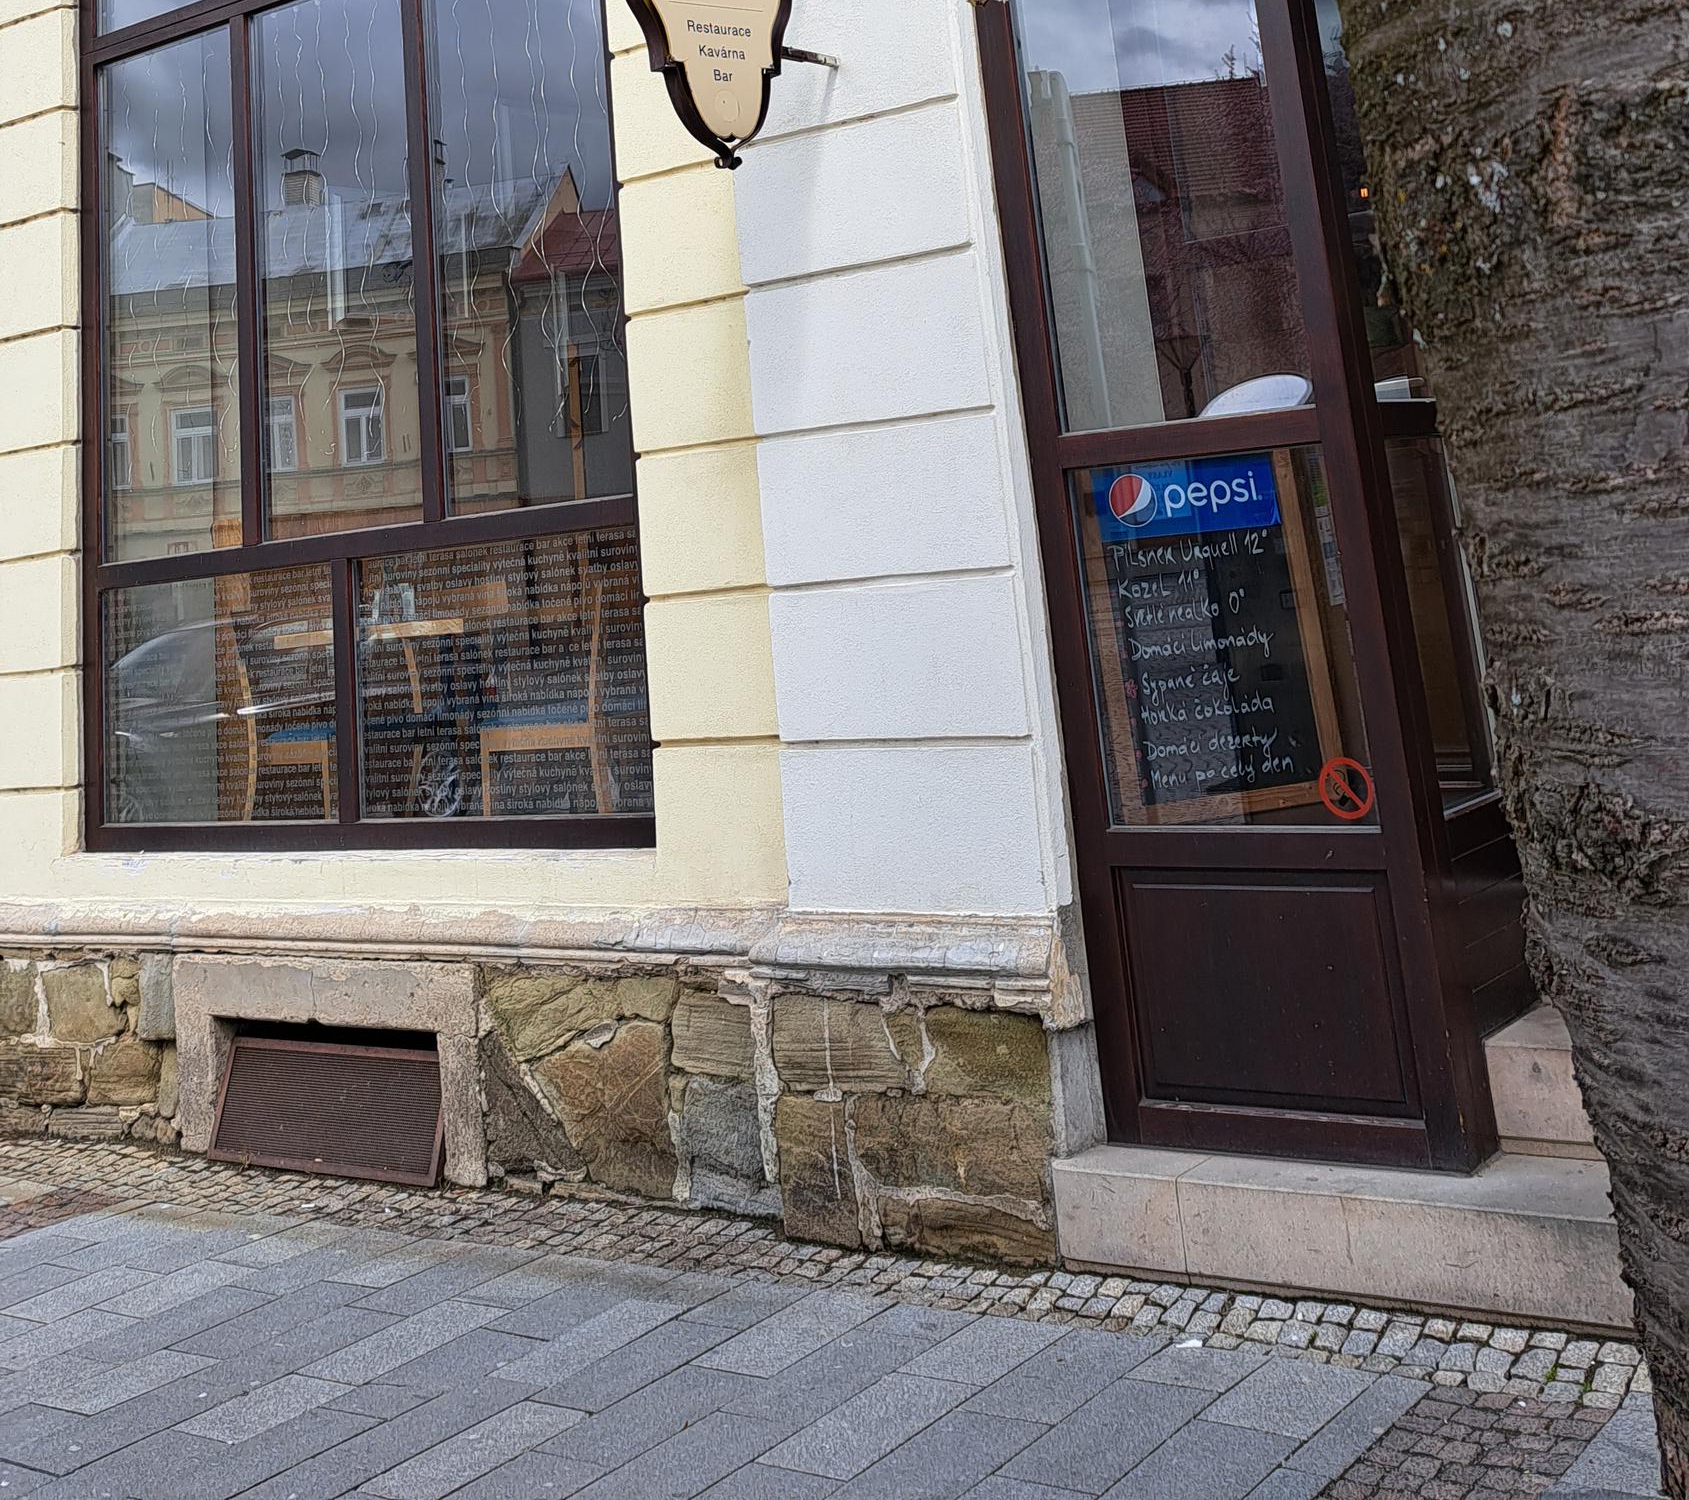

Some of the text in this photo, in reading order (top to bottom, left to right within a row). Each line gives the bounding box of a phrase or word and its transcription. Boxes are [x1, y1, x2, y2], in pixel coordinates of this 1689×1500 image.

[687, 20, 751, 37] Restaurace
[699, 45, 746, 60] Kavárna
[714, 69, 733, 82] Bar
[1163, 471, 1258, 517] pepsi
[542, 643, 557, 654] bar
[548, 751, 562, 761] bar
[1262, 753, 1294, 773] den
